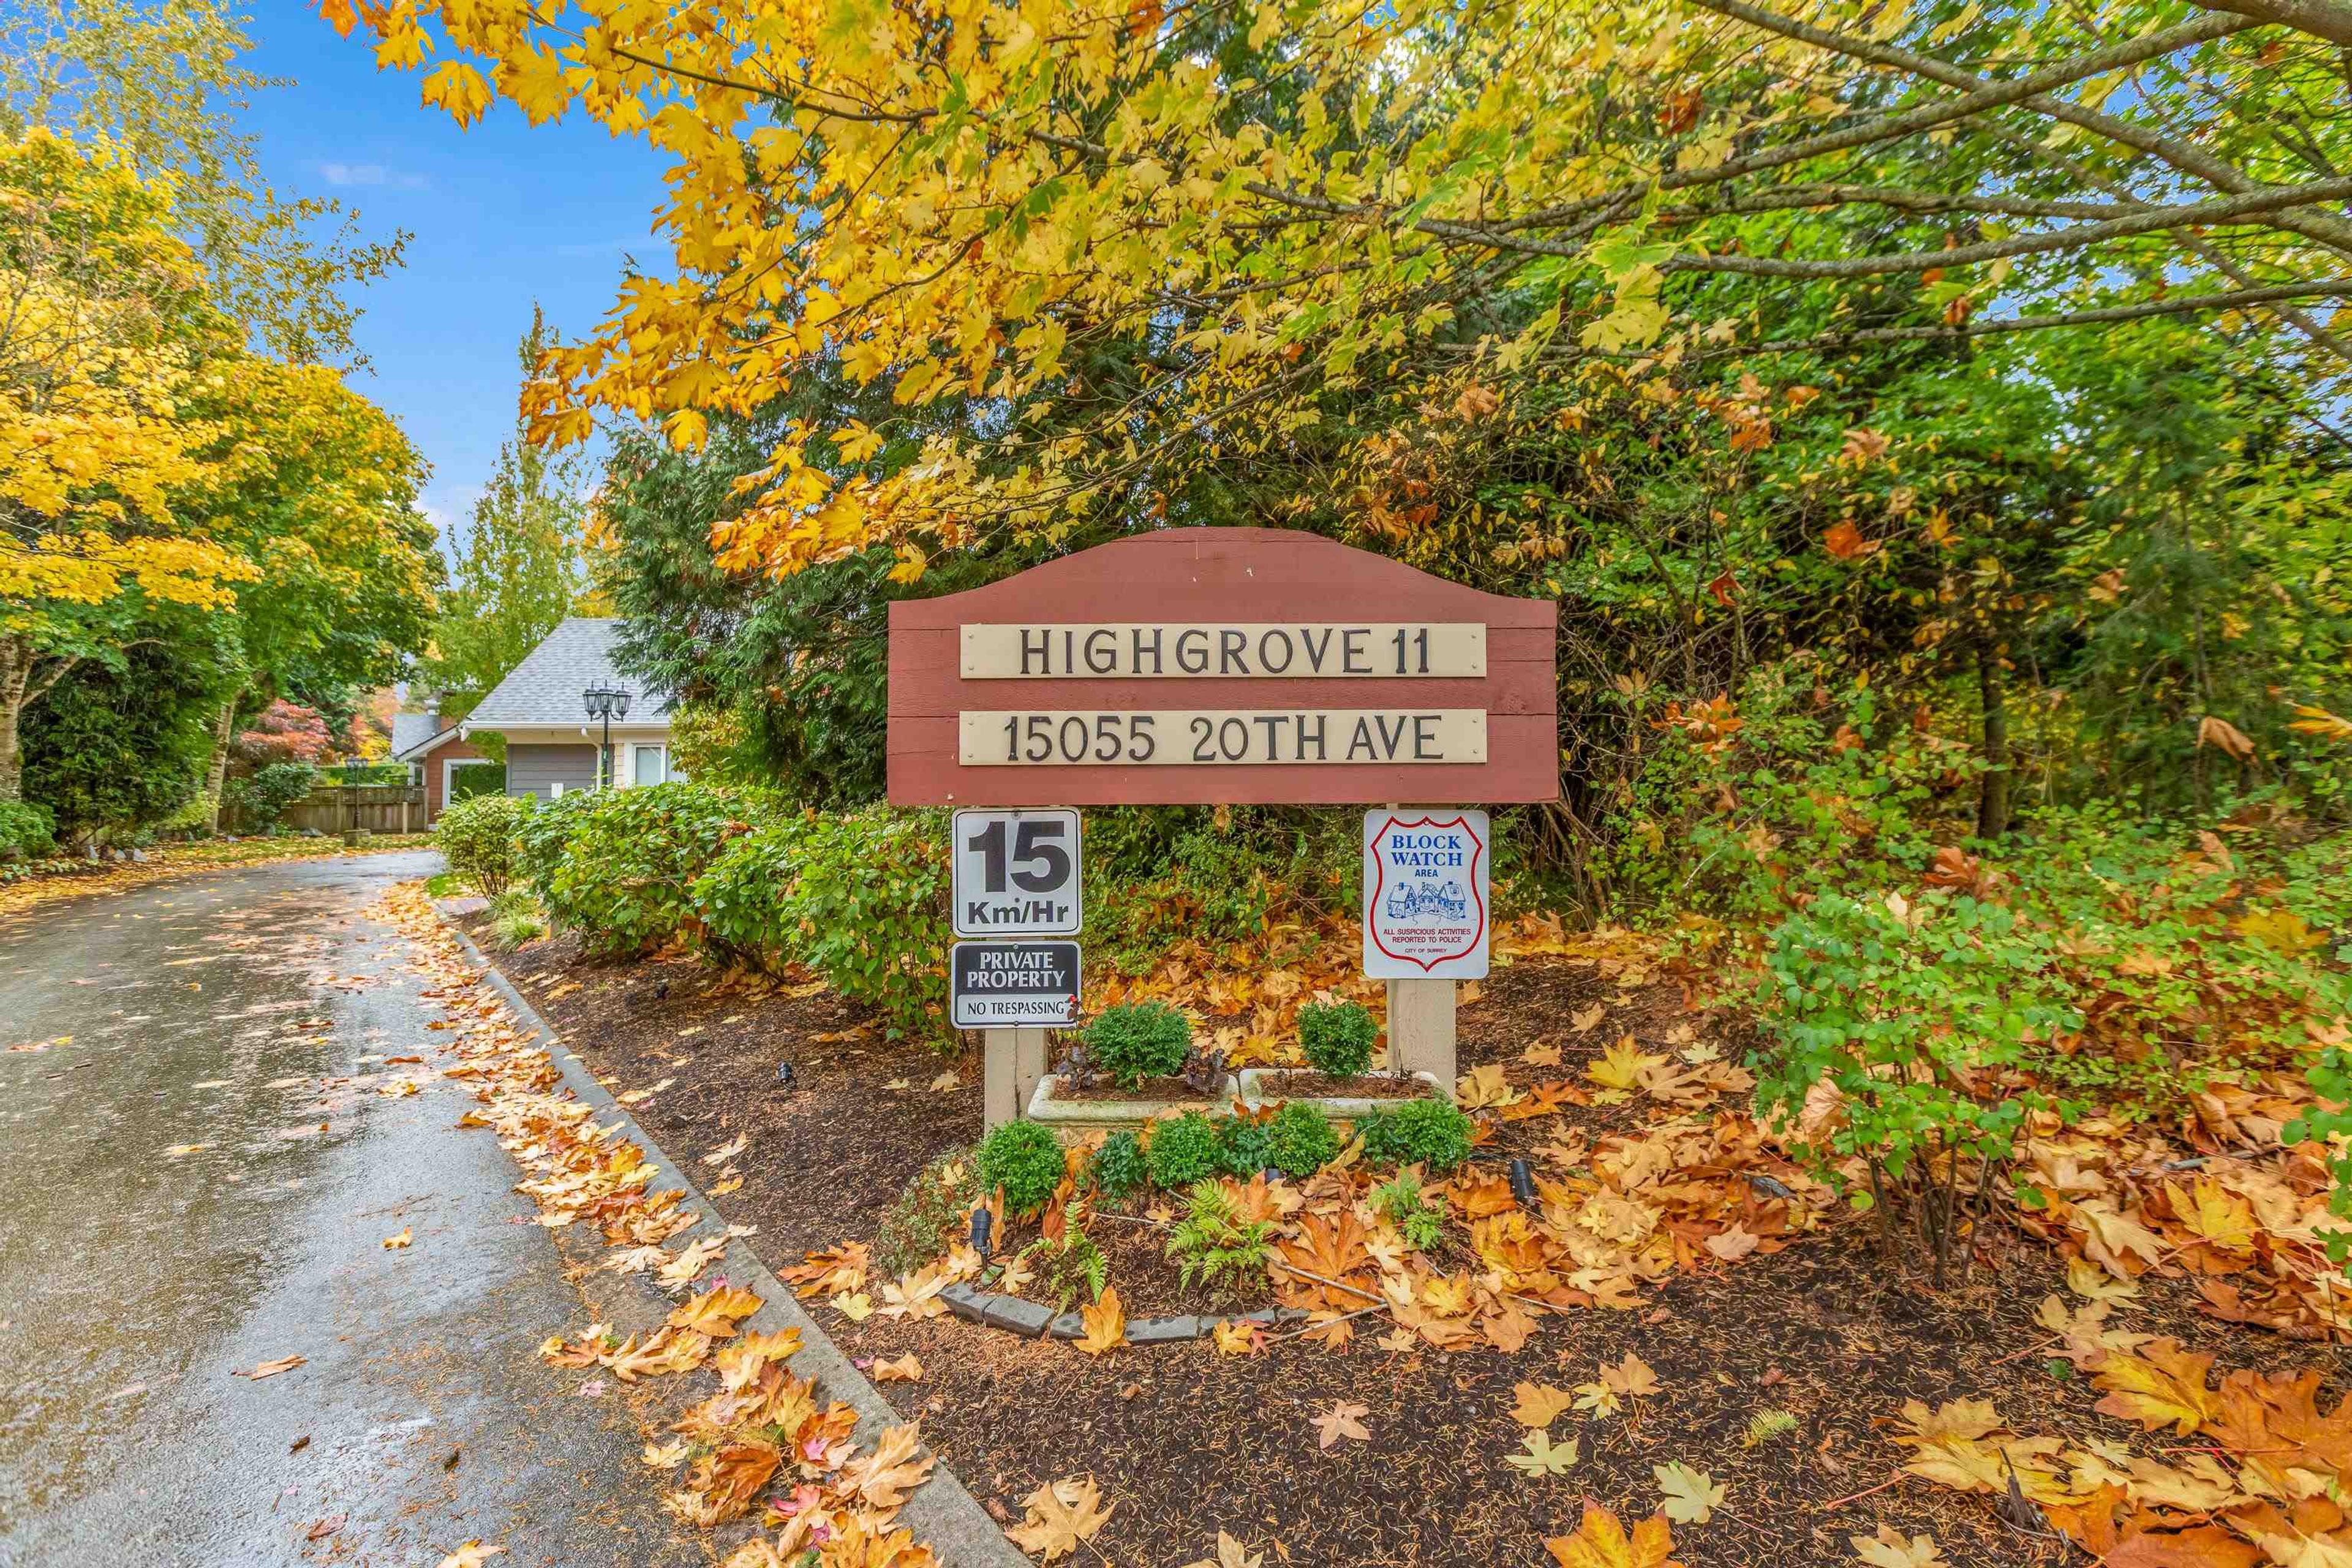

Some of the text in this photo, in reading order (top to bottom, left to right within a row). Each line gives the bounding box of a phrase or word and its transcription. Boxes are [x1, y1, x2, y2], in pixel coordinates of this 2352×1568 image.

[1020, 628, 1430, 675] HIGHGROVE 11
[1005, 714, 1444, 763] 15055 20TH AVE
[1392, 835, 1461, 849] BLOCK
[968, 821, 1071, 893] 15
[1390, 852, 1463, 866] WATCH
[968, 900, 1069, 924] Km/Hr
[979, 952, 1054, 970] PRIVATE
[967, 971, 1066, 988] PROPERTY
[968, 1001, 1065, 1015] NO TRESPASSING
